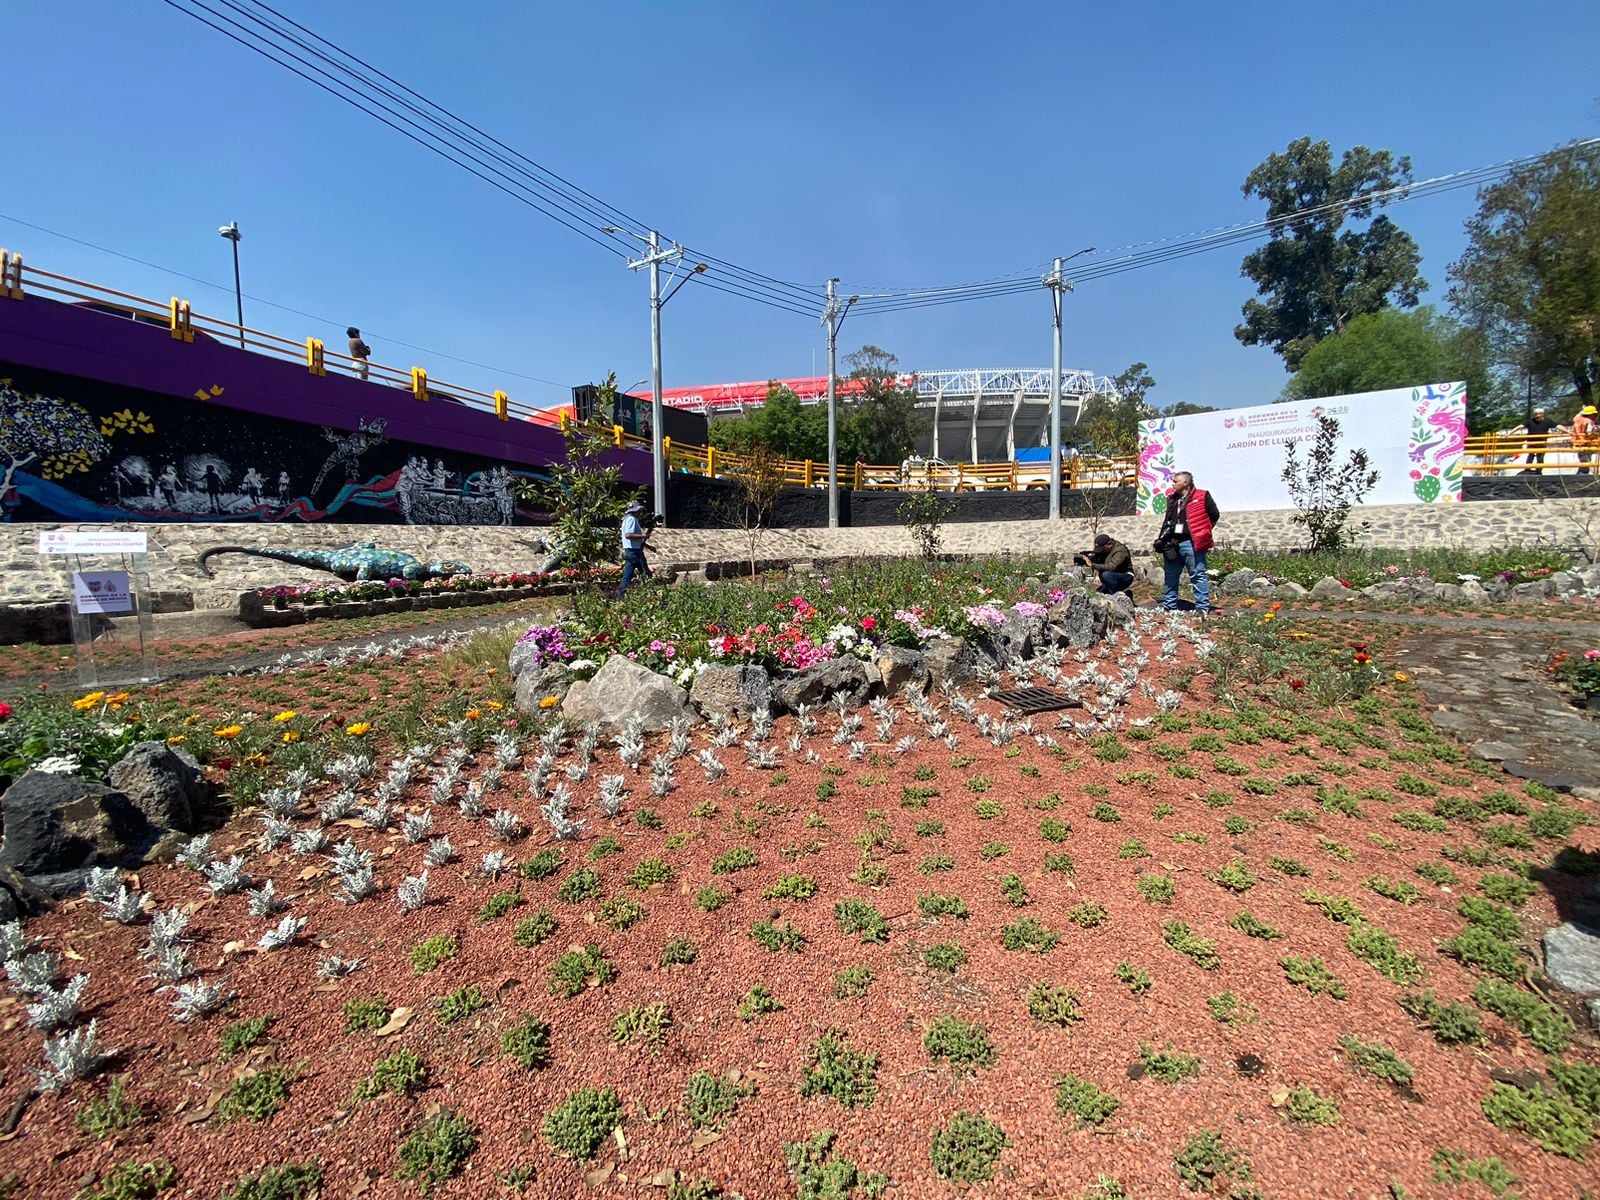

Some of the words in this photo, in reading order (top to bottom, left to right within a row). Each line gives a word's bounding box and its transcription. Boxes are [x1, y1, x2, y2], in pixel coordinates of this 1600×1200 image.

[662, 396, 702, 405] STADIO
[1247, 425, 1303, 438] INAUGURACIÓN
[1226, 439, 1257, 449] JARDÍN
[1272, 436, 1303, 446] LLUVIA
